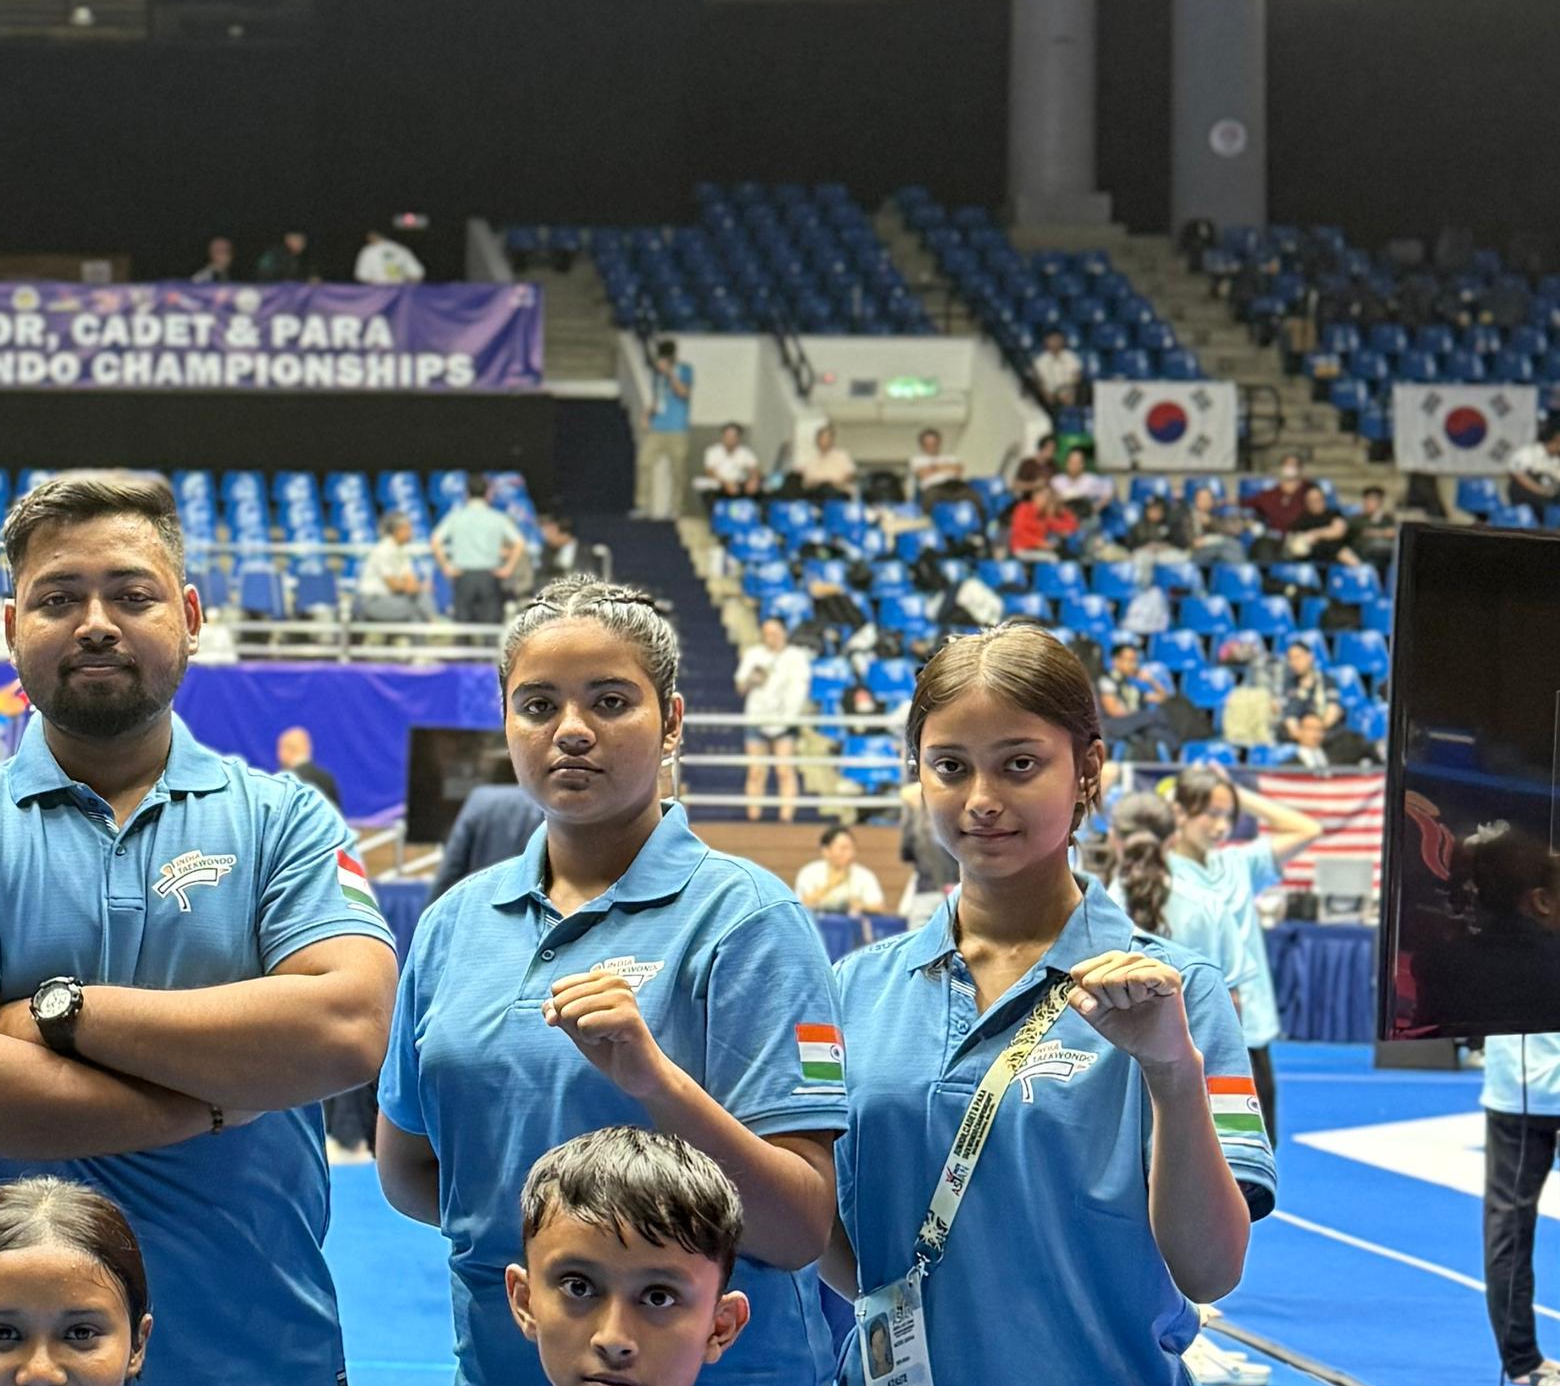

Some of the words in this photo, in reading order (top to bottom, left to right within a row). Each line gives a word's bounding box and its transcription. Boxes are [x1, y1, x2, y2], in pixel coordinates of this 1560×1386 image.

[71, 313, 217, 349] CADET
[225, 315, 261, 349] &
[270, 314, 395, 349] PARA
[90, 351, 476, 387] CHAMPIONSHIPS
[177, 856, 235, 875] TAEKWONDO
